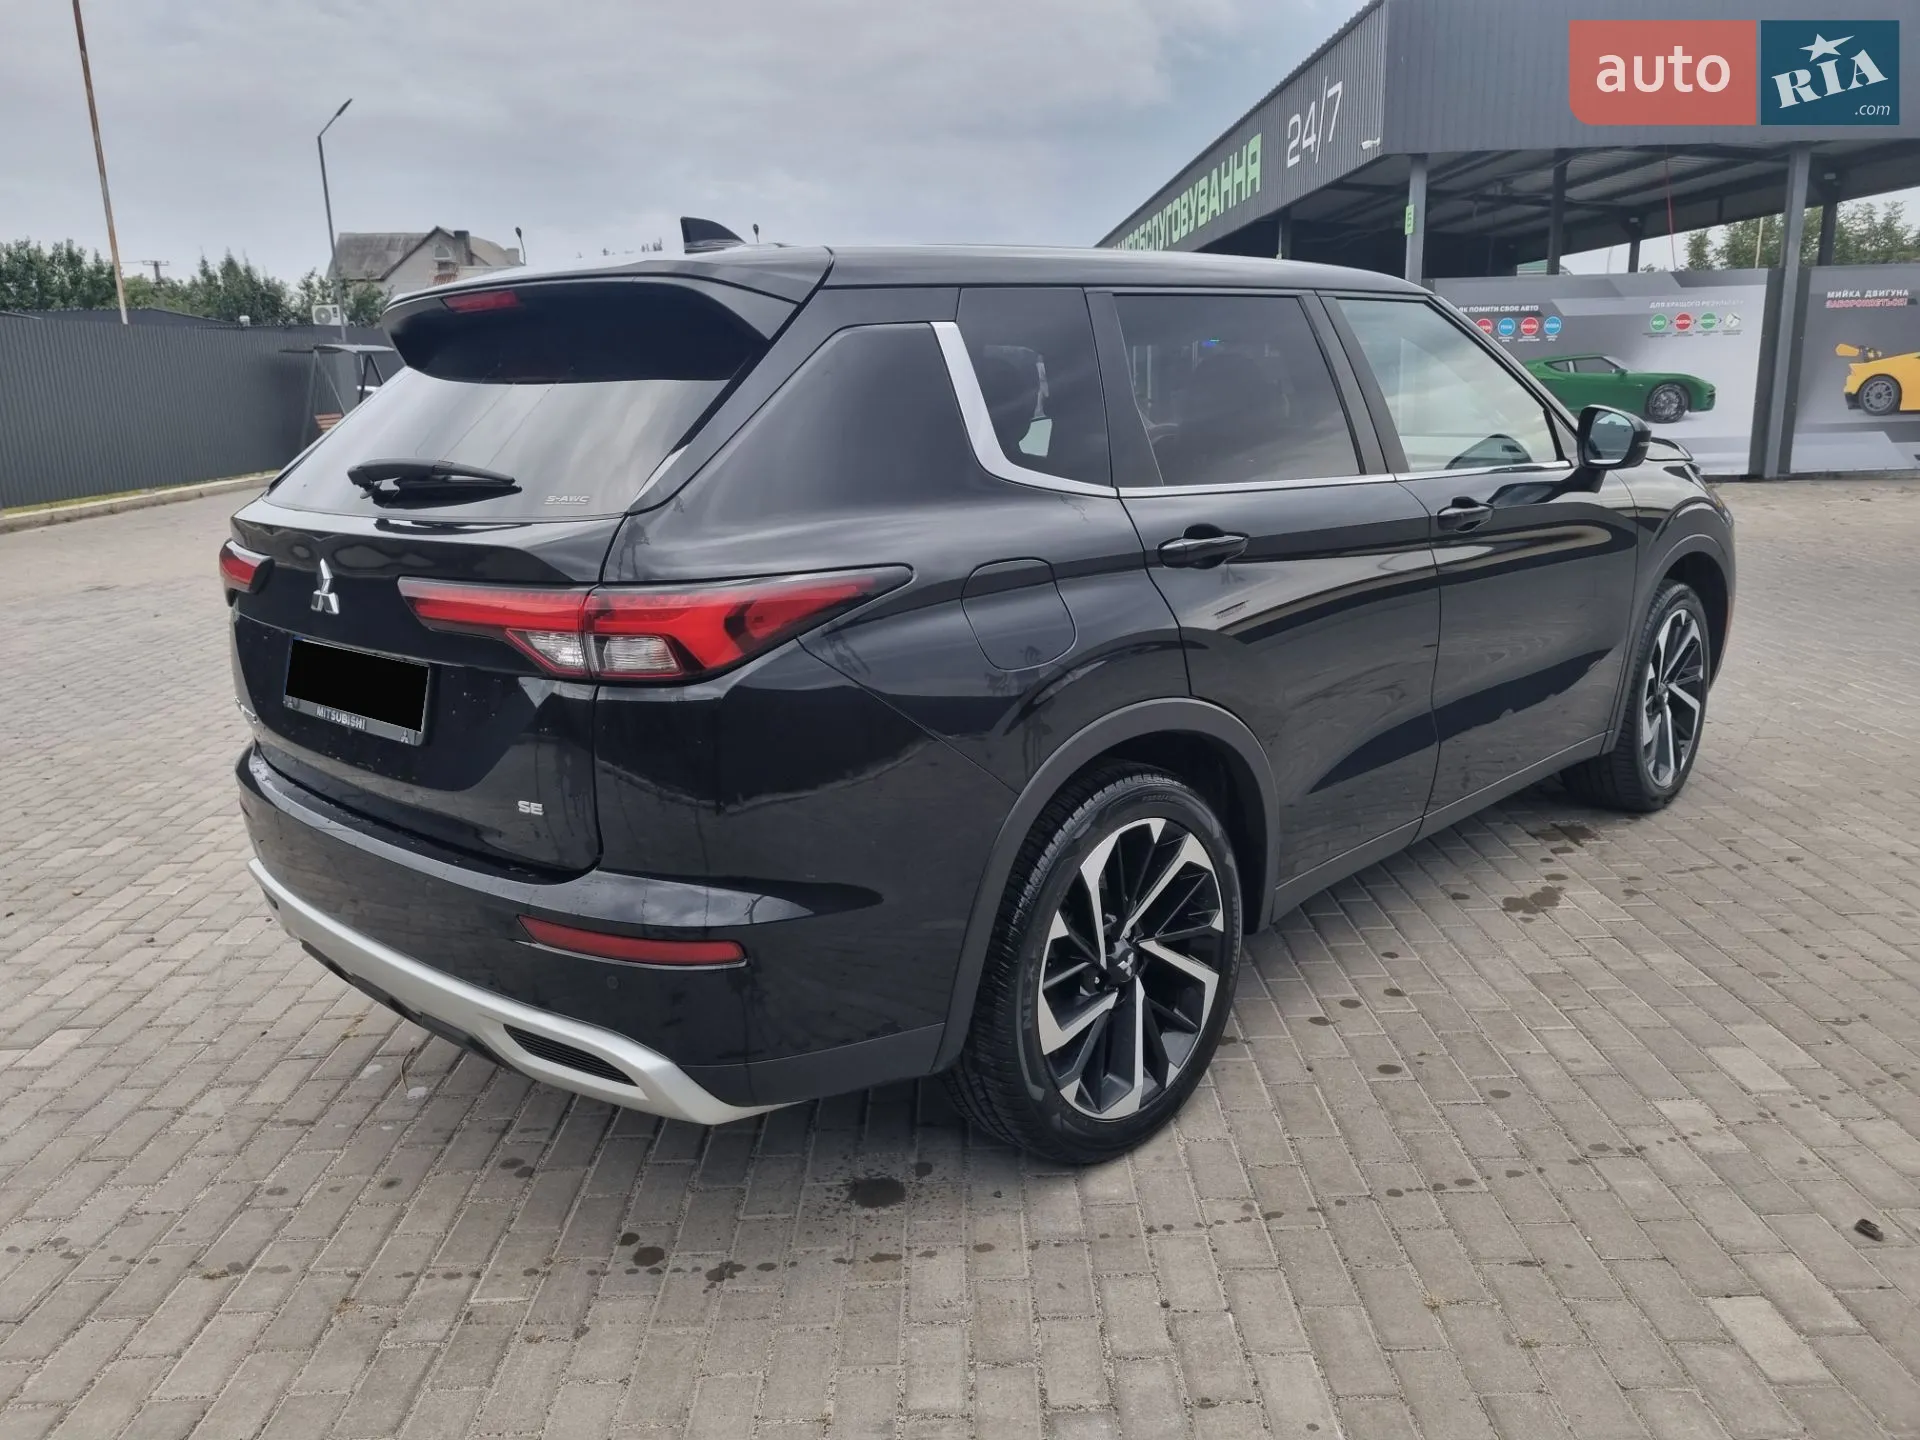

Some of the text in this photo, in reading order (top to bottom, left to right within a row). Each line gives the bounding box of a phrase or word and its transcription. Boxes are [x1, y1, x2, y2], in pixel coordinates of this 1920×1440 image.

[1286, 75, 1343, 169] 24/7
[1827, 288, 1909, 299] МИЙКА ДВИГУНА
[1468, 305, 1499, 313] ПОМИТИ
[1520, 304, 1539, 312] АВТО
[544, 495, 591, 503] S-AWC
[315, 704, 367, 731] MITSUBISHI
[517, 800, 545, 816] SE
